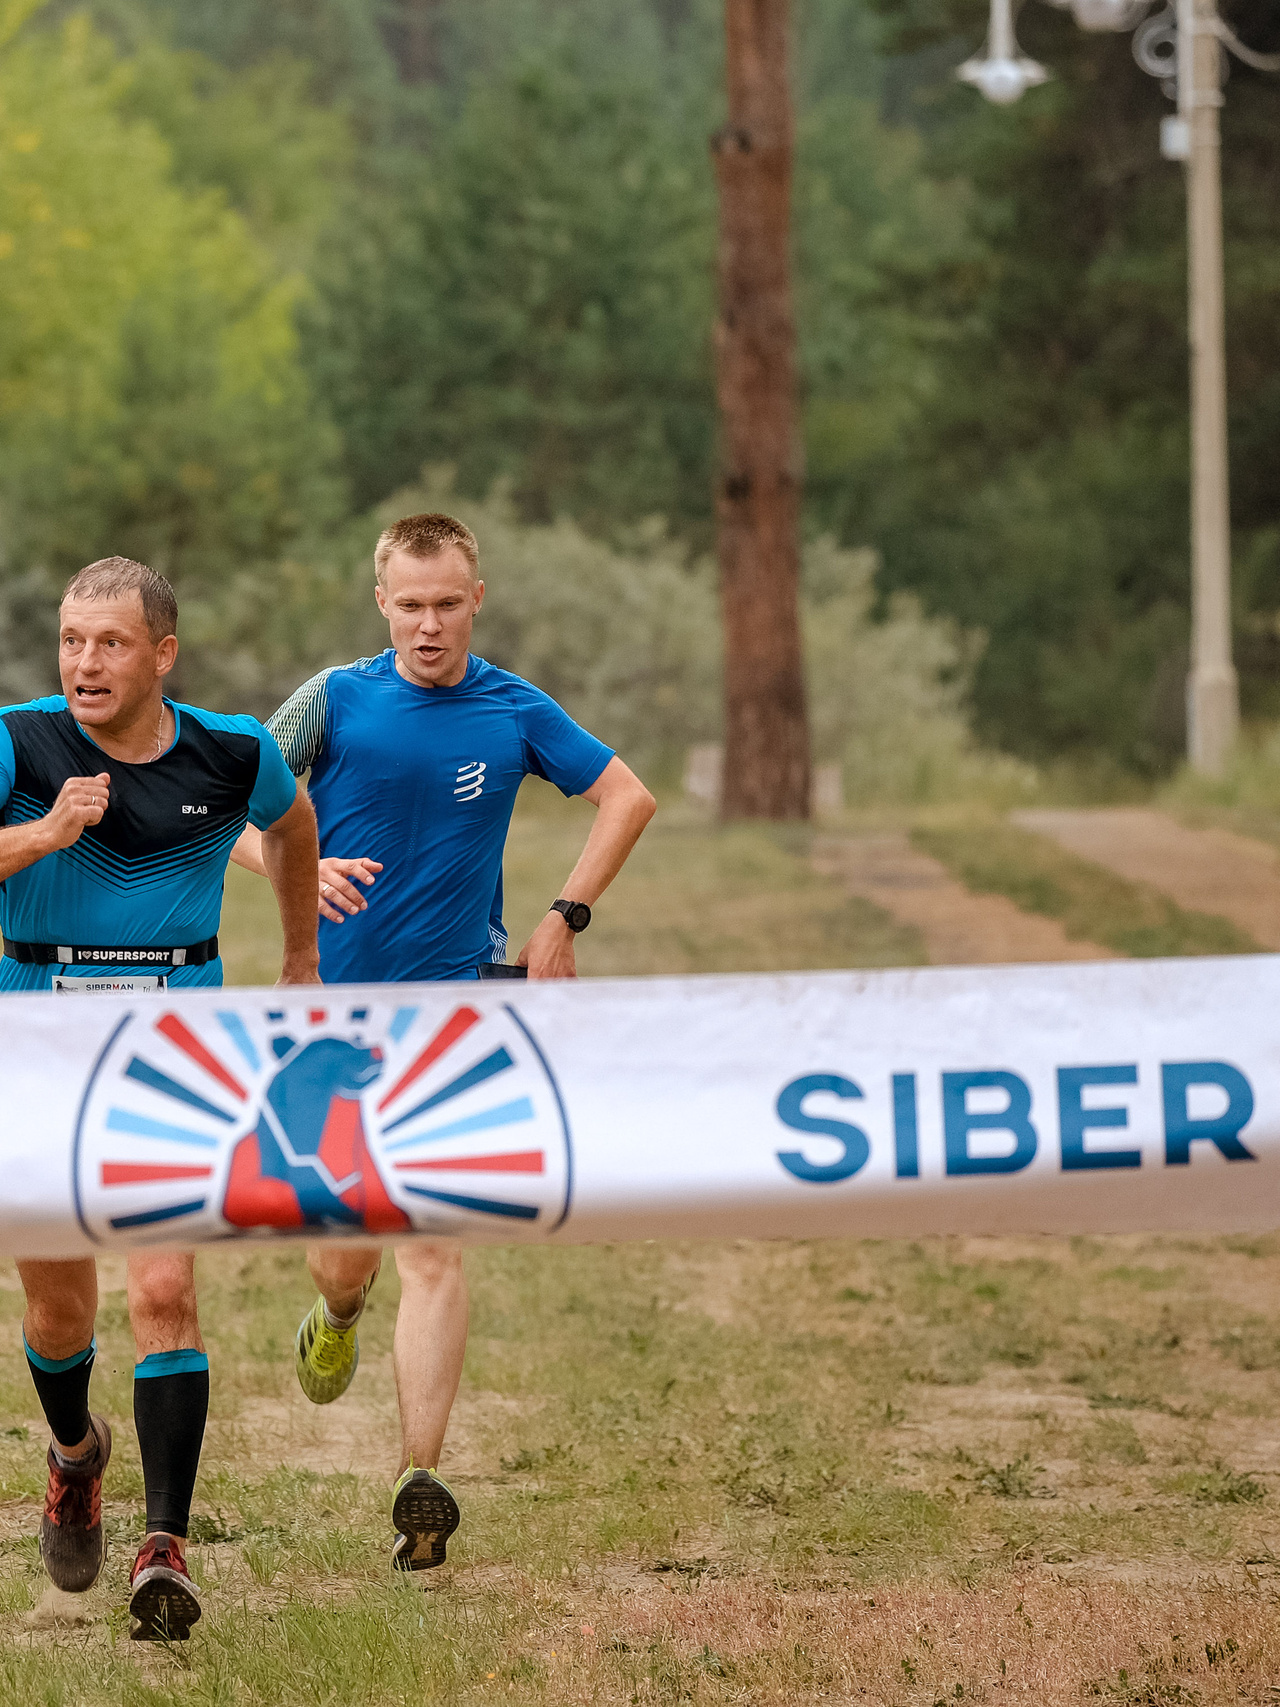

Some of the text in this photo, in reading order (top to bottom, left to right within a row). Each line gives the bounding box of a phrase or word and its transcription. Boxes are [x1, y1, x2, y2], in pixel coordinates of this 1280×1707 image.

[92, 950, 170, 961] SUPERSPORT
[86, 983, 134, 991] SIBERMAN
[774, 1060, 1258, 1184] SIBER
